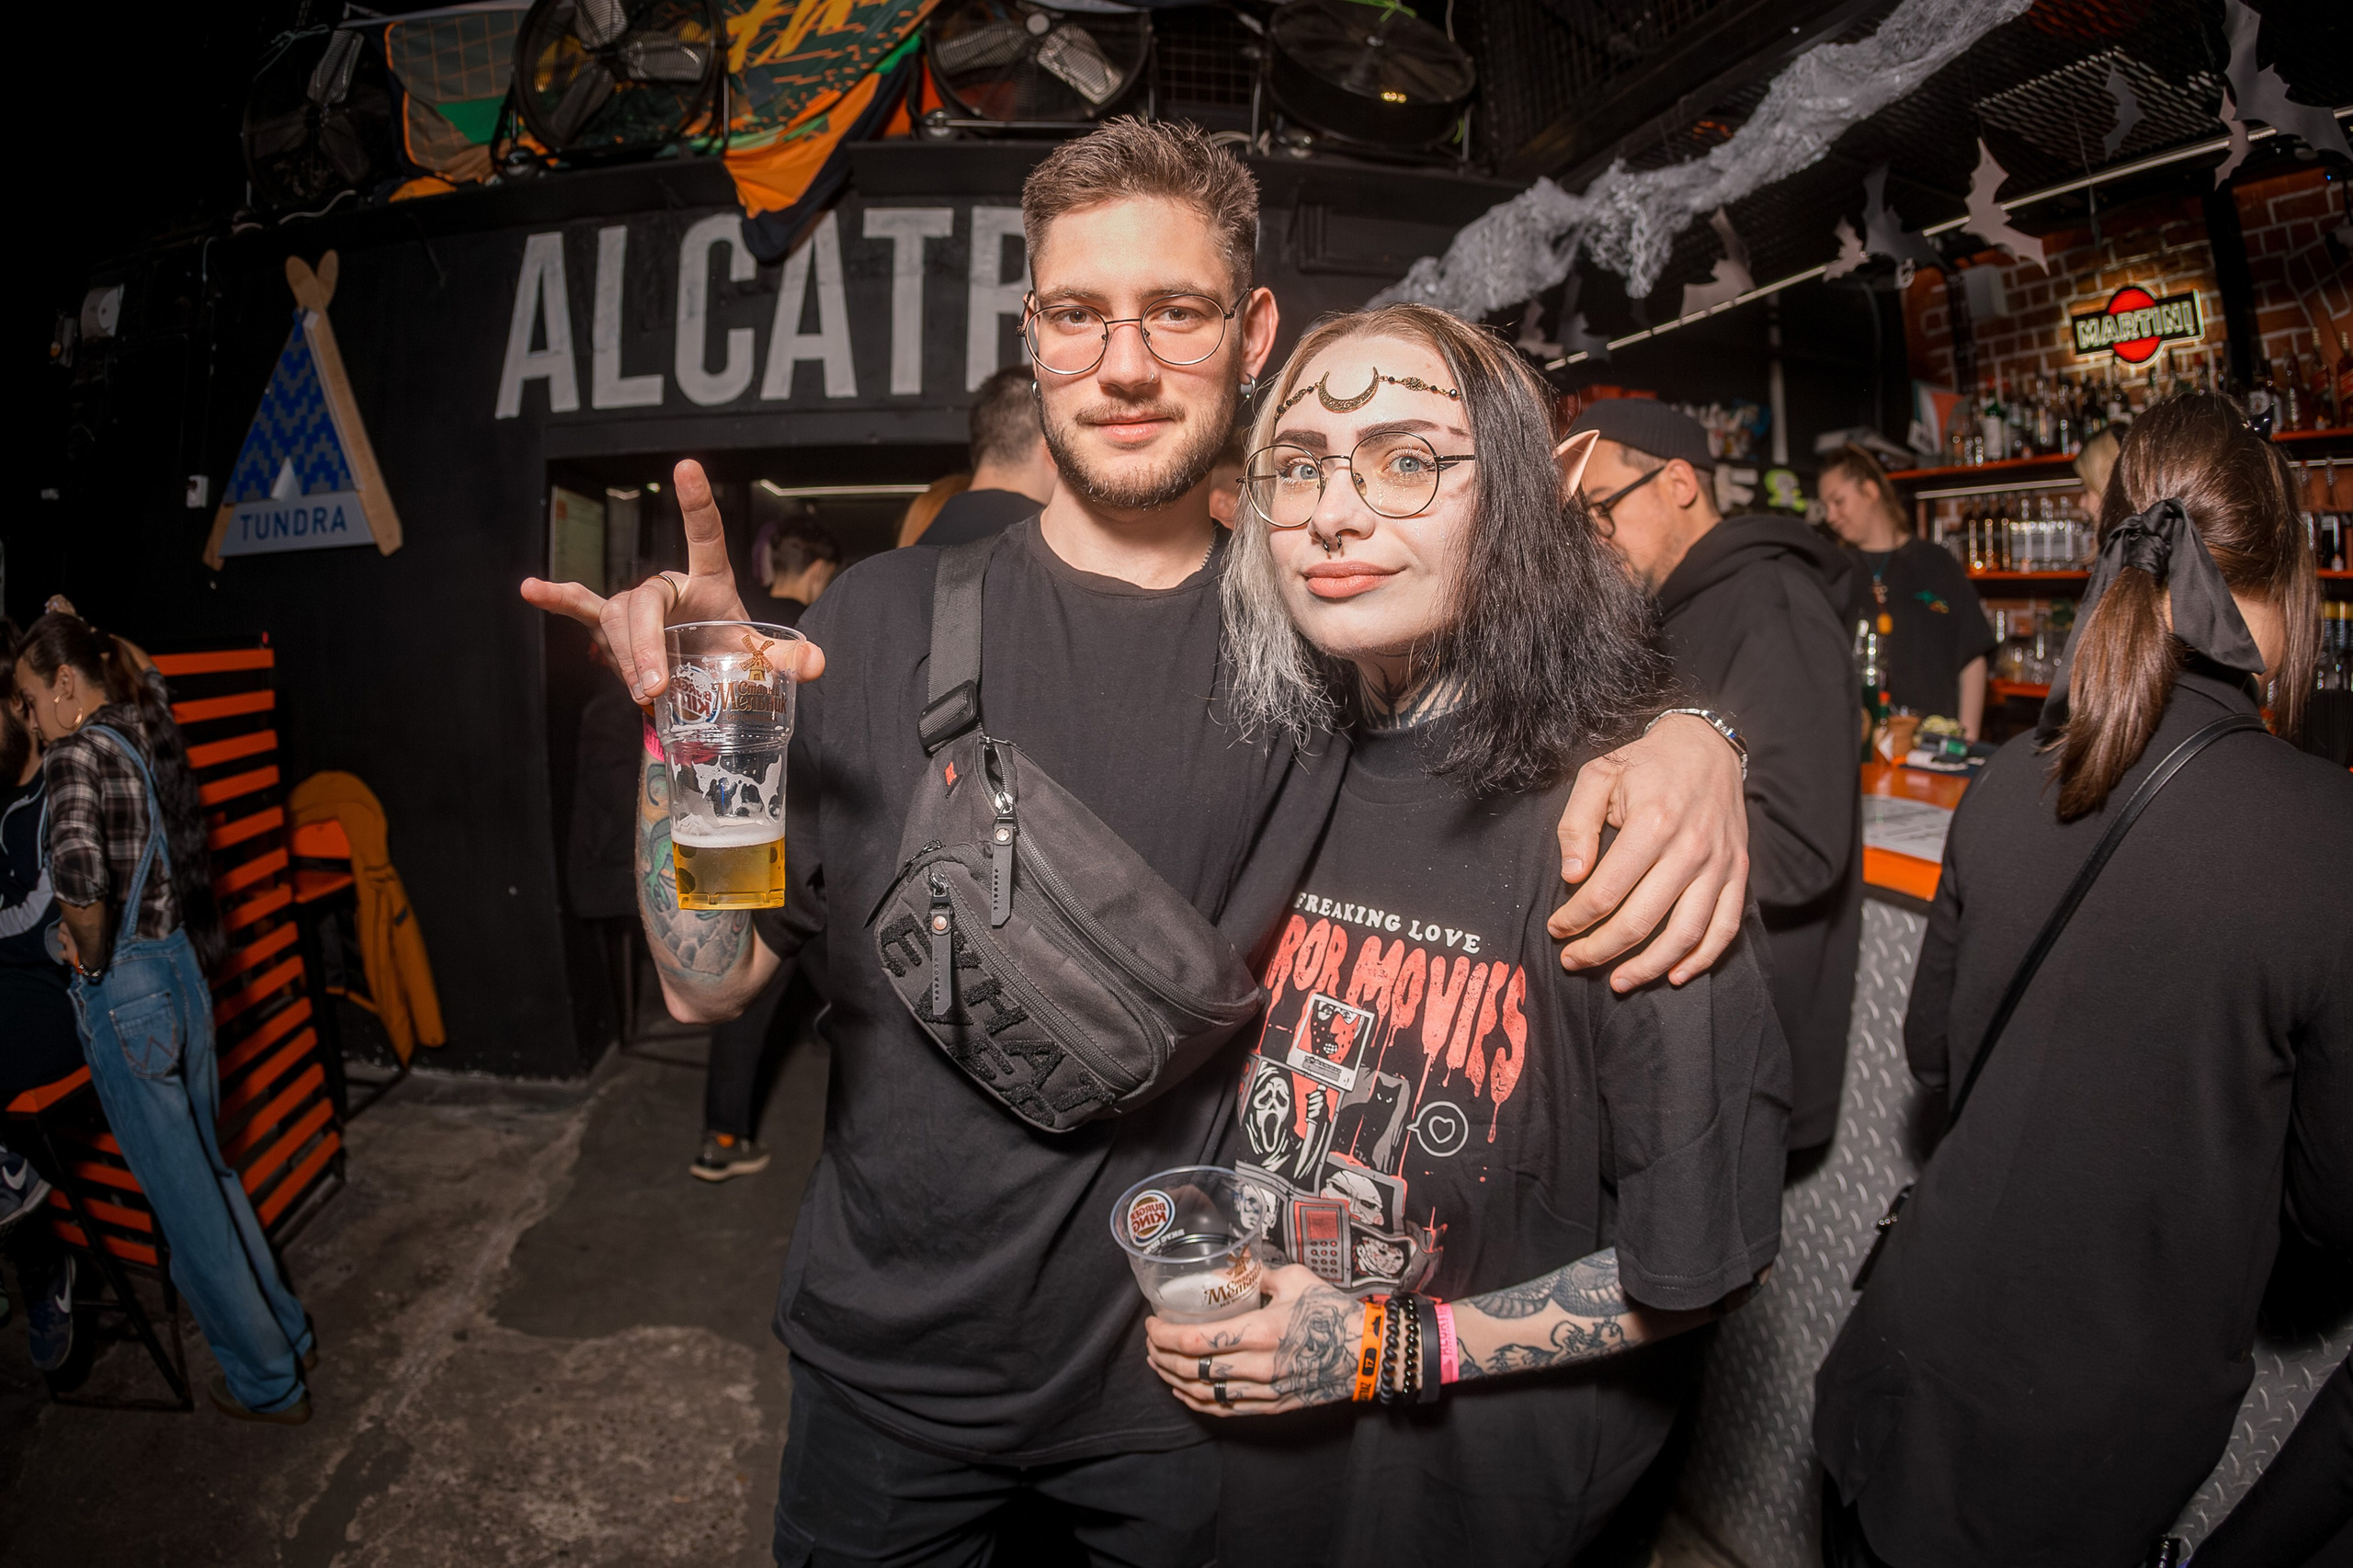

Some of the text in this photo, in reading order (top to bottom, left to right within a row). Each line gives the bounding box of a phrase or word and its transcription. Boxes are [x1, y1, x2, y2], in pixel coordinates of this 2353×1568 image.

[2076, 301, 2195, 349] MARTINI
[239, 505, 347, 542] TUNDRA
[711, 681, 788, 714] Мельник
[1292, 892, 1481, 954] FREAKING LOVE
